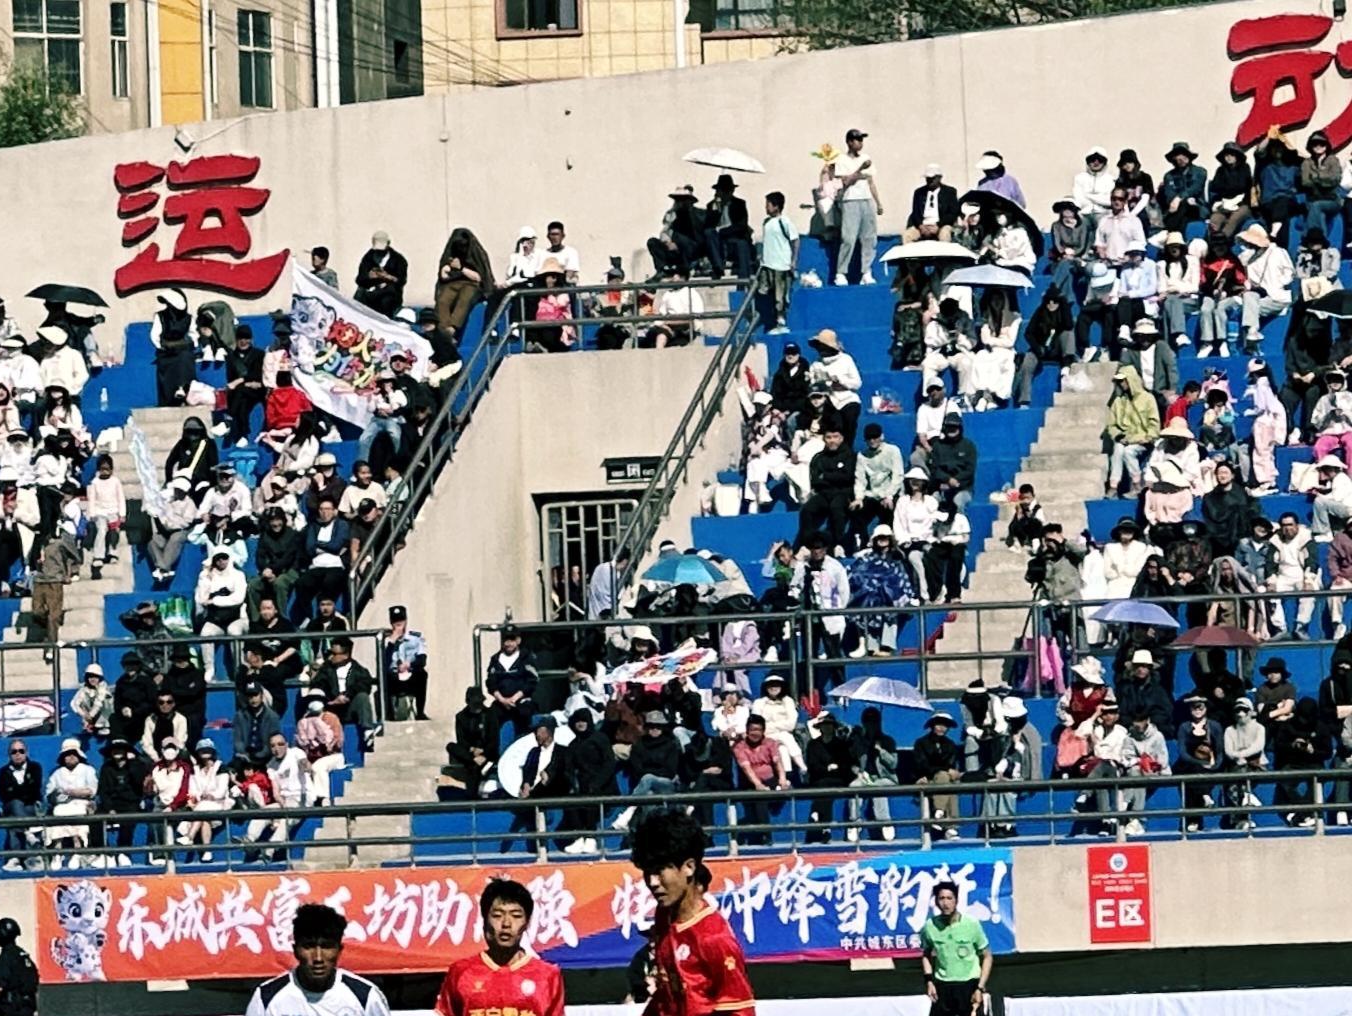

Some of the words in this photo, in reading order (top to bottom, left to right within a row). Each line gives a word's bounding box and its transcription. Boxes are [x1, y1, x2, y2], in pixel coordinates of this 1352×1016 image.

[114, 154, 290, 300] 运
[116, 868, 579, 962] 东城共富坊助强
[611, 859, 1008, 944] 牦冲锋雪豹狂！
[1095, 898, 1145, 929] E区
